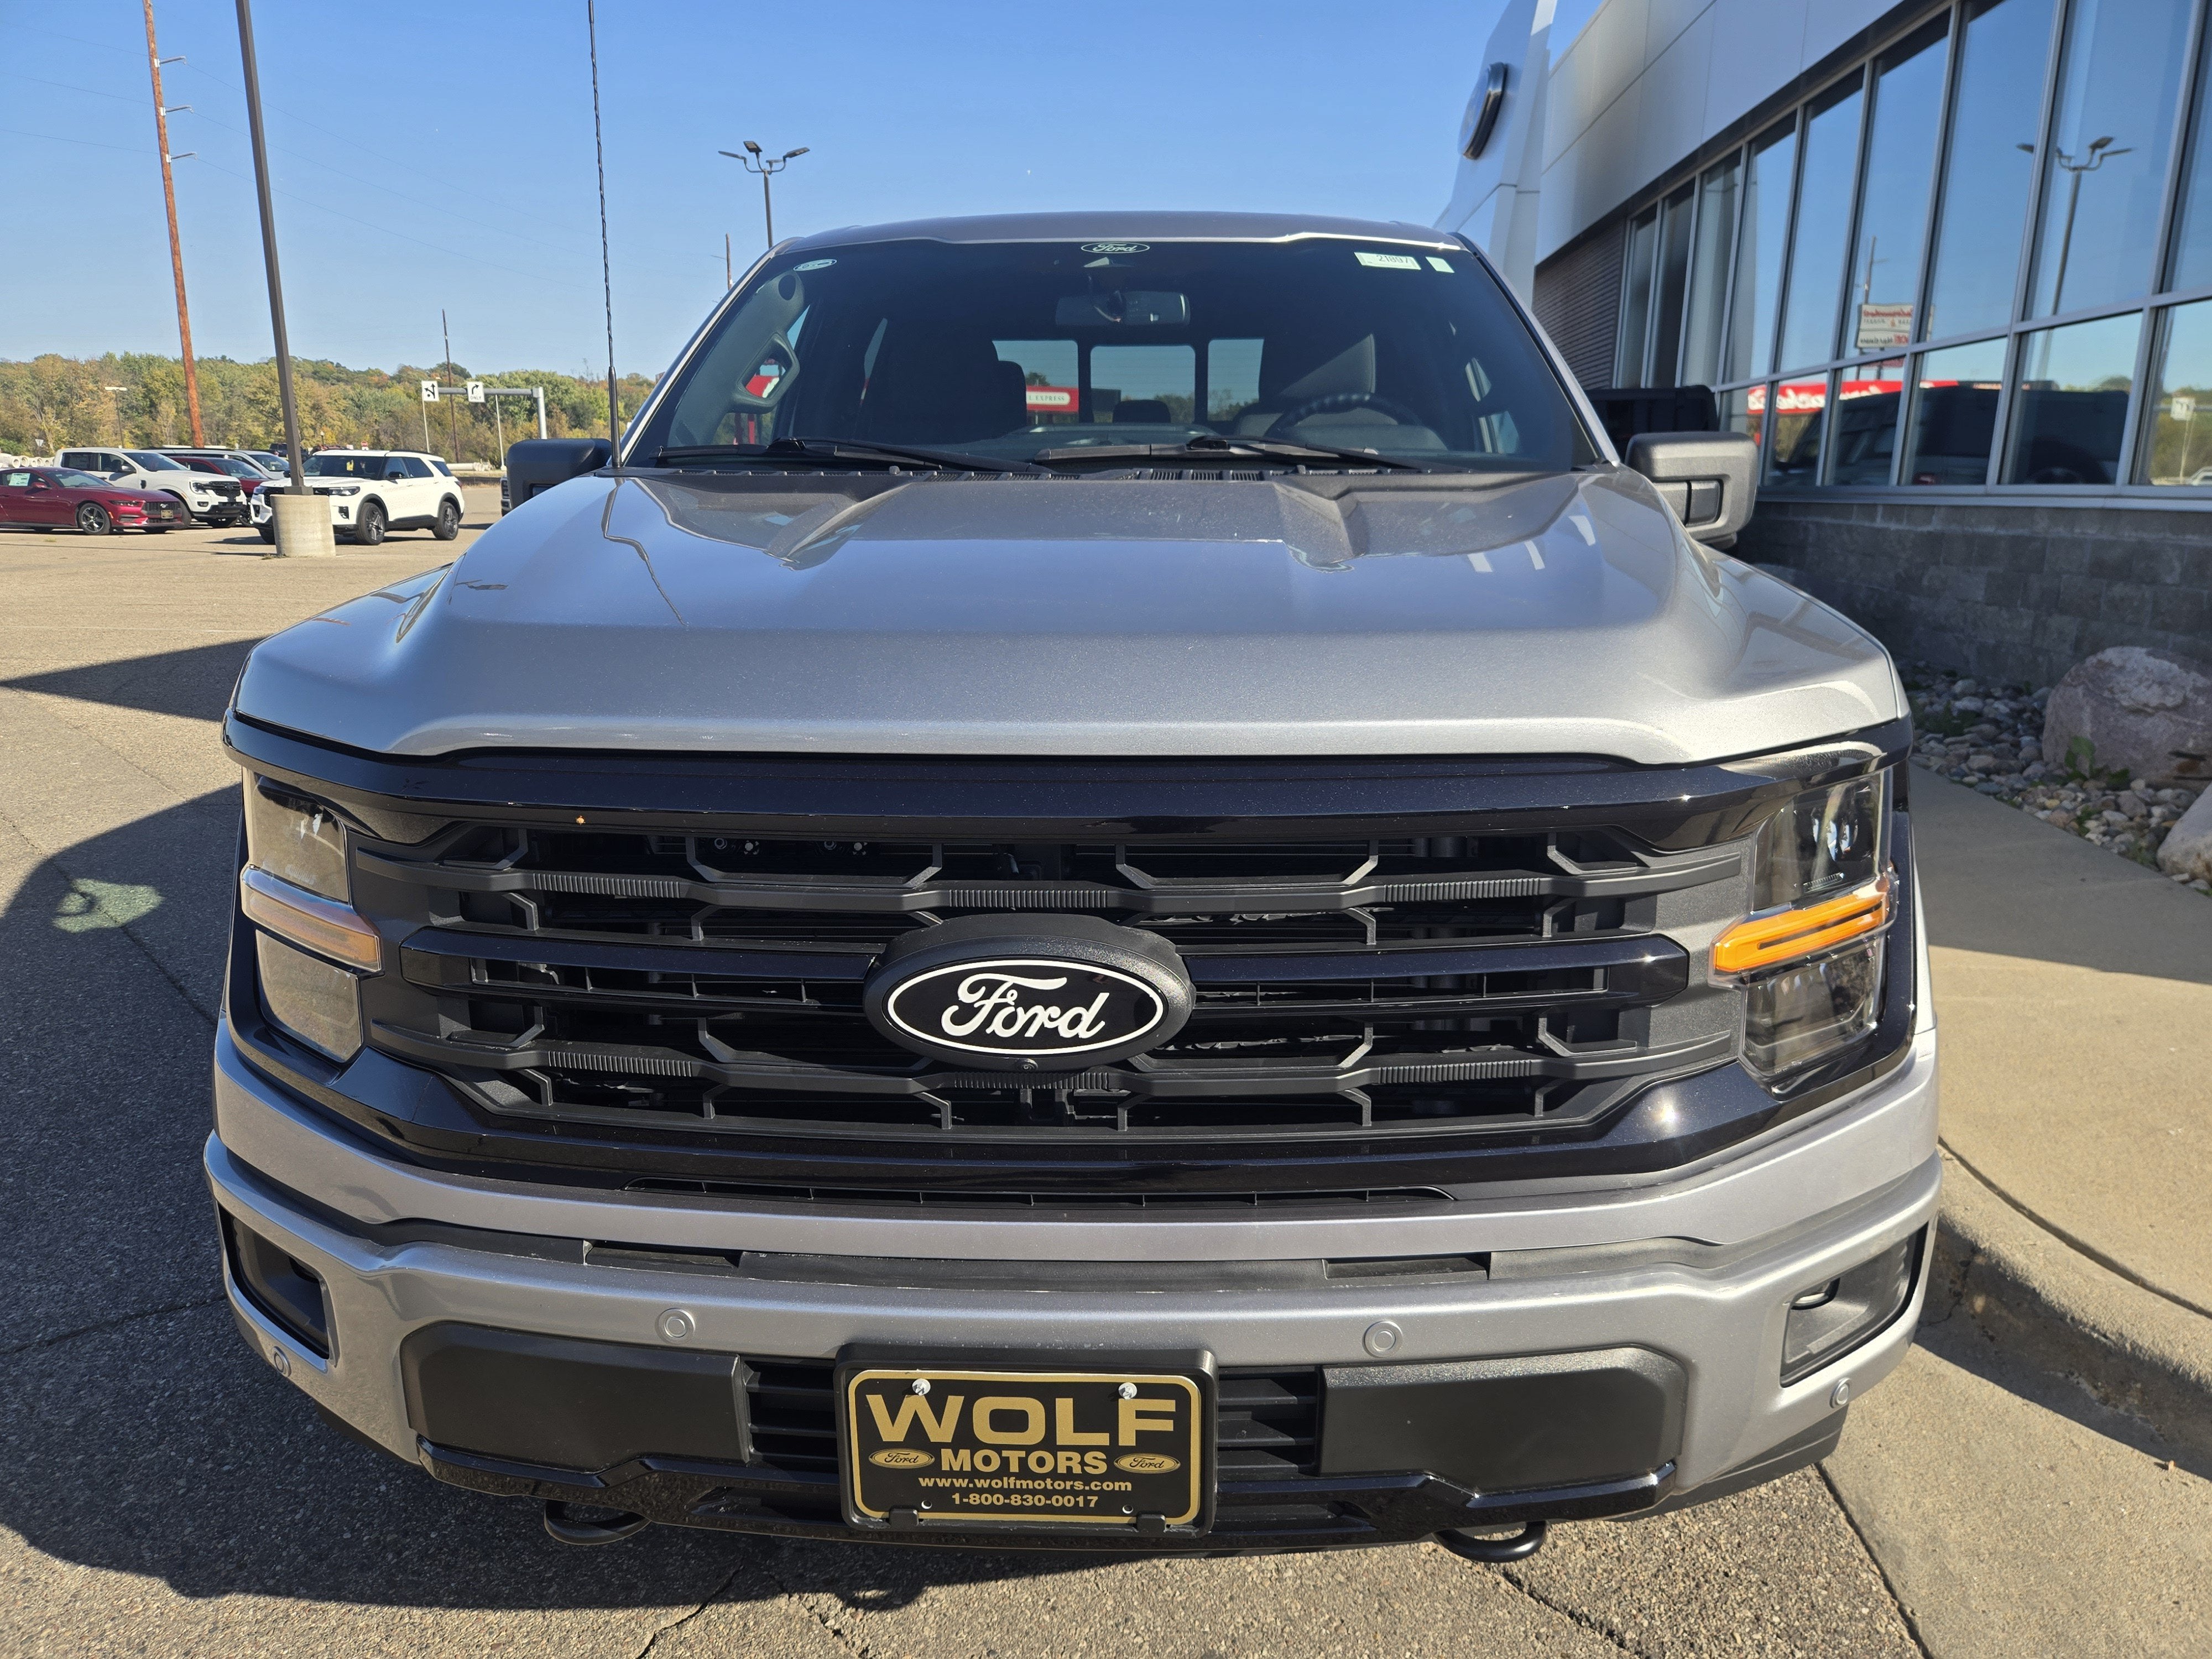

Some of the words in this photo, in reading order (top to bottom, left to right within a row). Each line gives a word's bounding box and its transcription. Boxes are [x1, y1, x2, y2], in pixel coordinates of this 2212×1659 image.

[1093, 243, 1138, 252] Ford
[941, 973, 1110, 1039] Ford
[865, 1394, 1176, 1446] WOLF
[884, 1452, 919, 1463] Ford
[941, 1448, 1107, 1474] MOTORS
[1129, 1457, 1165, 1468] Ford
[918, 1477, 1133, 1491] www.wolfmotors.com
[952, 1493, 1099, 1508] 1-800-830-0017
